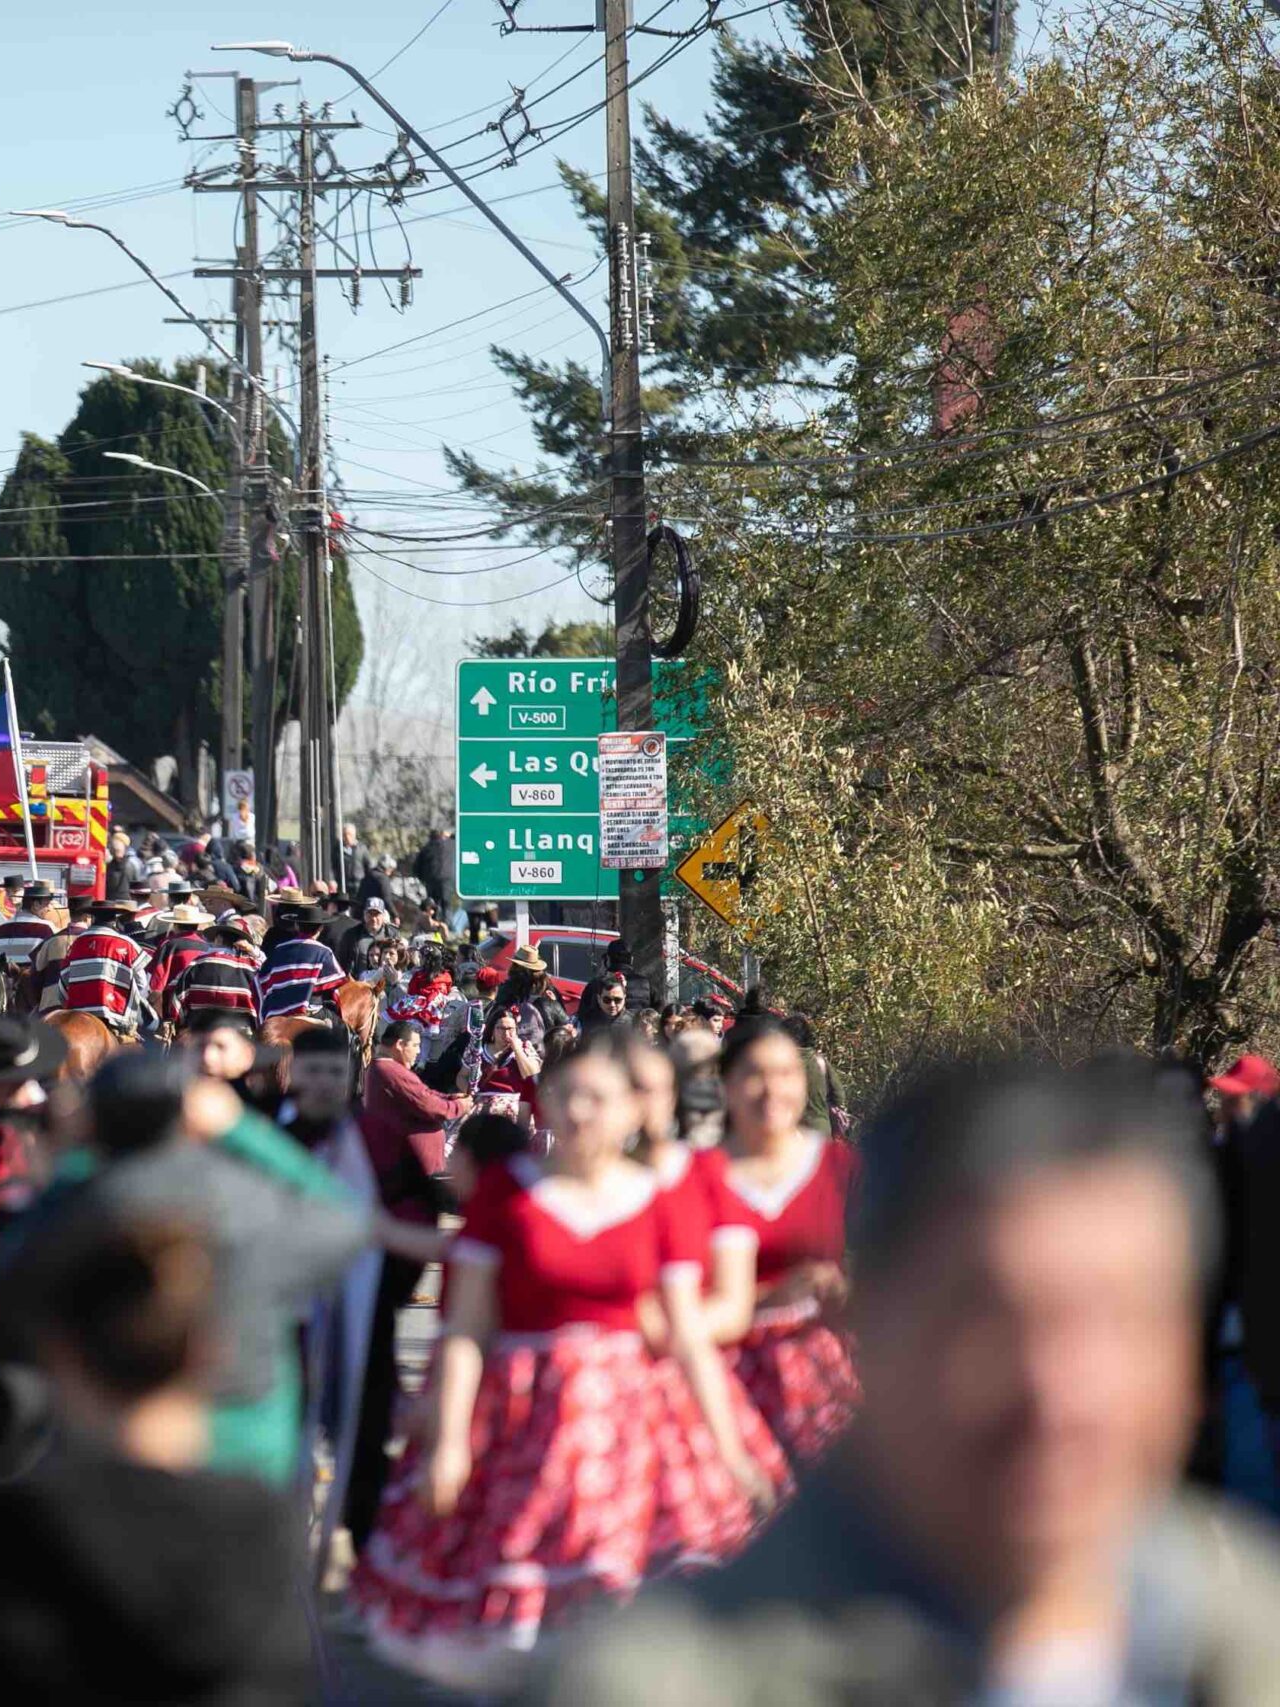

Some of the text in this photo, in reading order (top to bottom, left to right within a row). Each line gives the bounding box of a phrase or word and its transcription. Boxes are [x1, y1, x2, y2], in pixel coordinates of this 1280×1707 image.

[509, 670, 557, 693] Río
[518, 712, 557, 724] V-500
[509, 750, 558, 773] Las
[518, 789, 555, 801] V-860
[61, 832, 82, 846] 132
[518, 867, 555, 878] V-860
